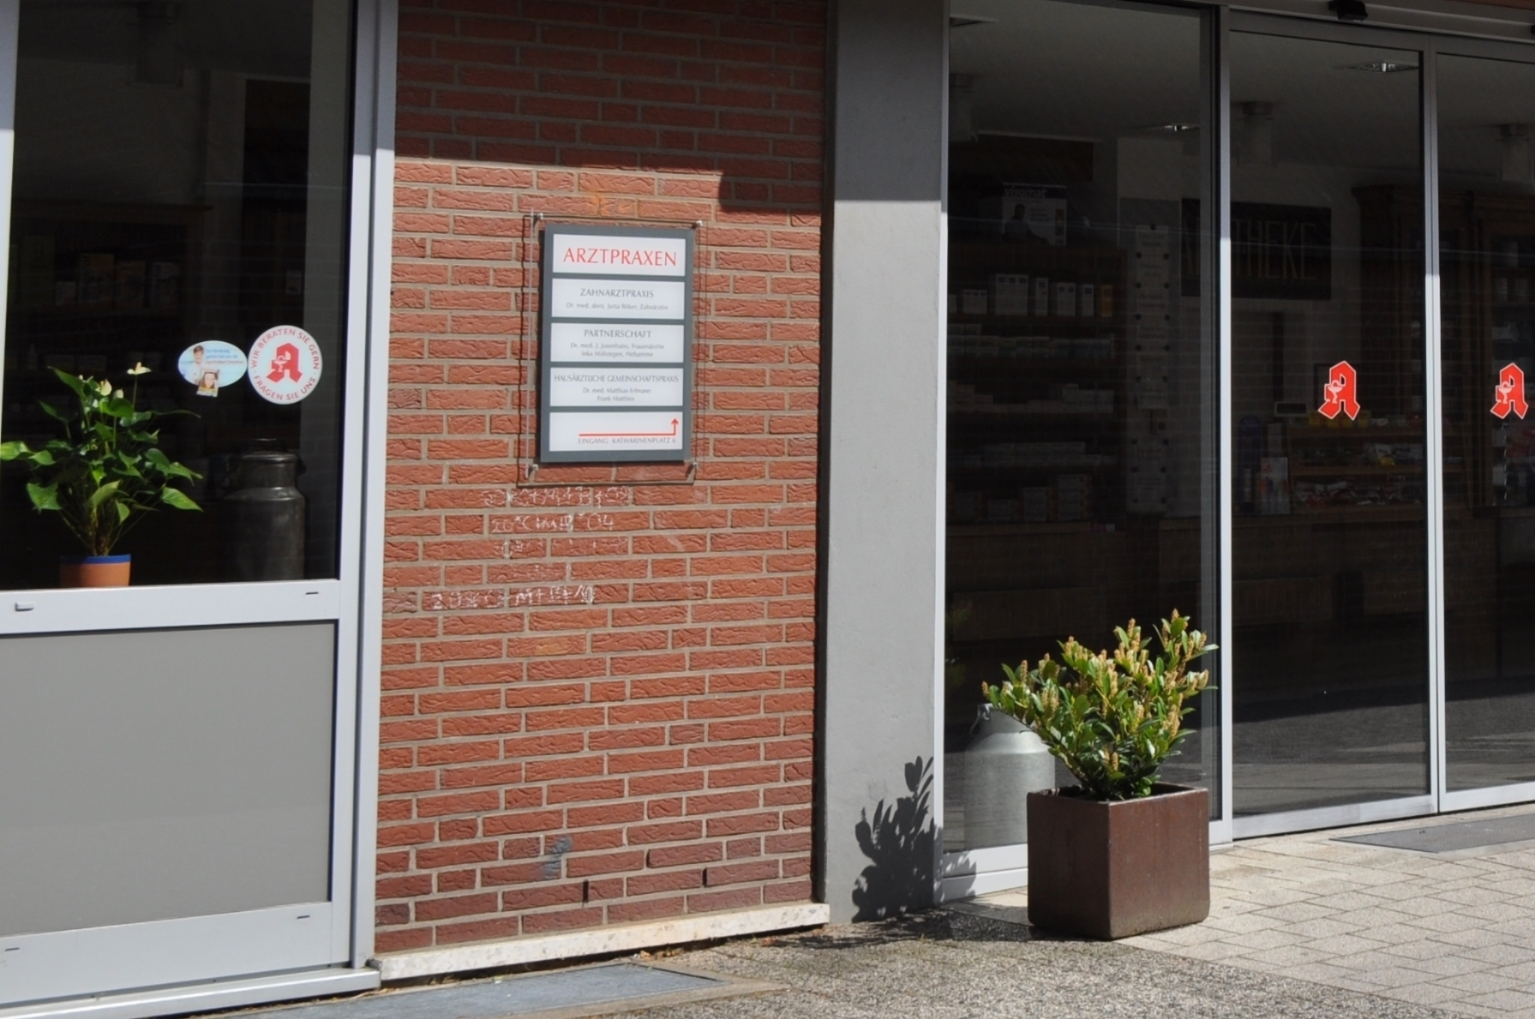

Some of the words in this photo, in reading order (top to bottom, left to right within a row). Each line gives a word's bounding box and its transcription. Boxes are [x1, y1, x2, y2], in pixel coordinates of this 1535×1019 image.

[563, 247, 677, 267] ARZTPRAXEN
[580, 288, 655, 299] ZAHNARZTPRAXIS
[584, 329, 652, 338] PARTNERSCHAFT
[251, 348, 261, 369] WIR
[257, 328, 296, 348] BERATEN
[296, 331, 311, 344] SIE
[308, 344, 320, 371] GERN
[554, 372, 606, 382] HAUSÄRZTLICHE
[606, 374, 679, 383] GEMEINSCHAFTSPRAXIS
[253, 374, 284, 401] FRAGEN
[286, 392, 300, 401] SIE
[300, 377, 317, 395] UNS
